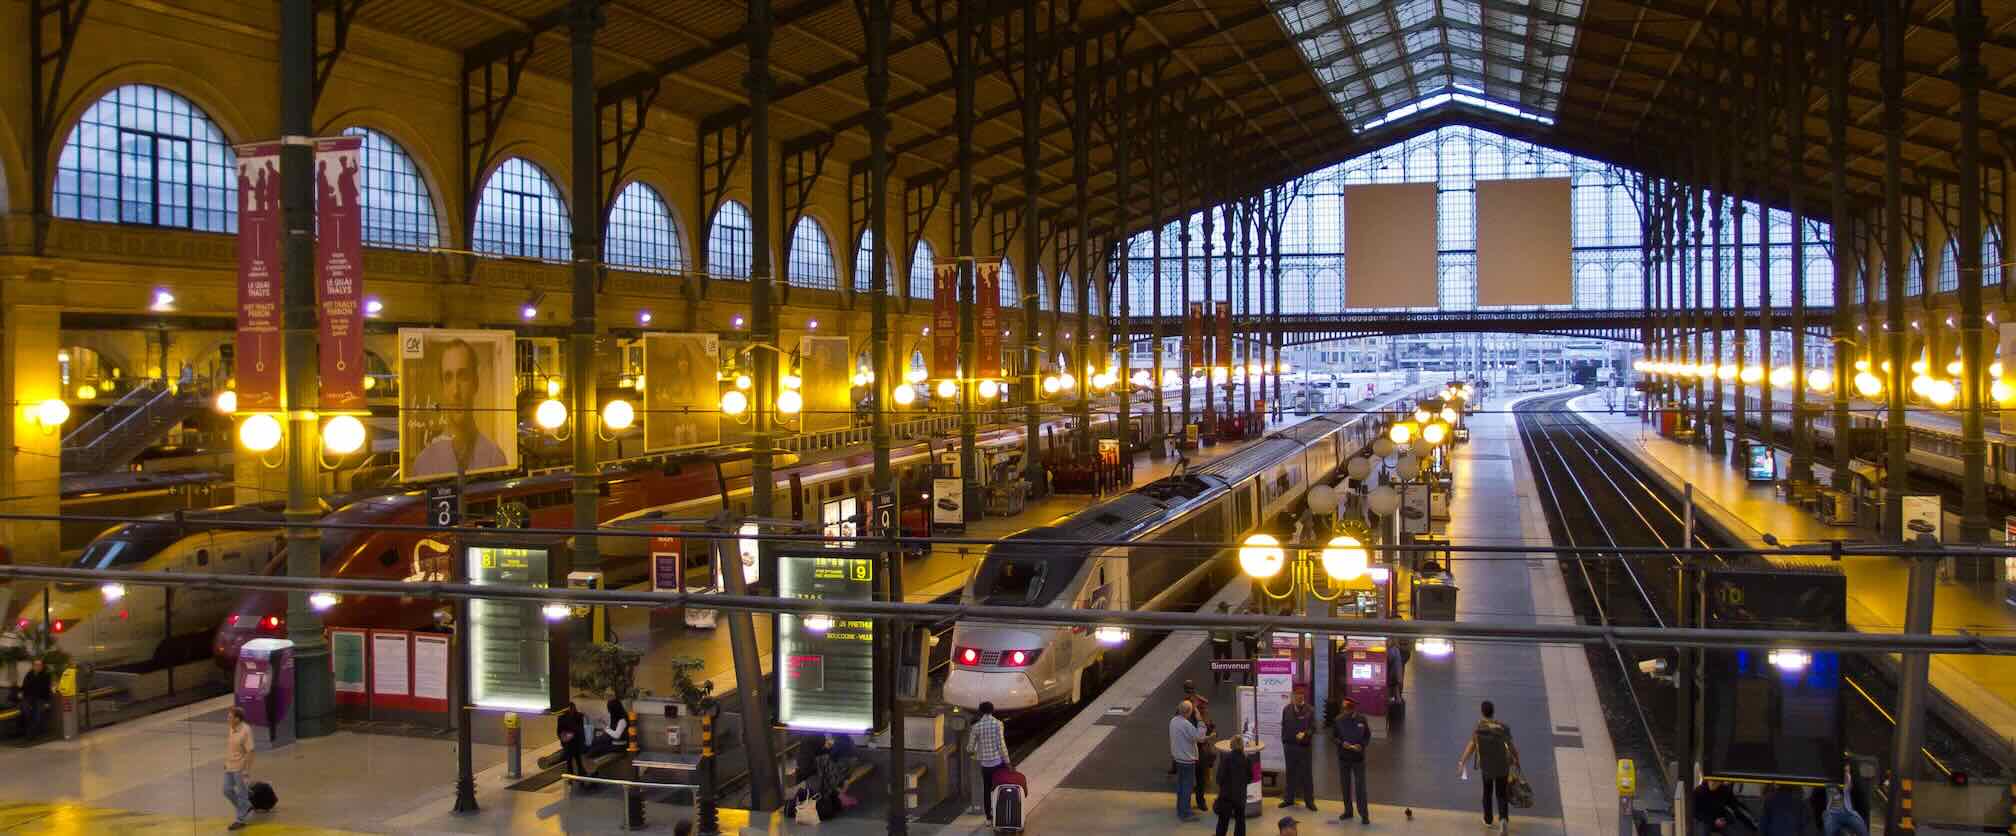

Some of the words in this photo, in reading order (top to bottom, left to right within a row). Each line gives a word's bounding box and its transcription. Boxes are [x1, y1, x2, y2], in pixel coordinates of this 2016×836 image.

[881, 510, 890, 537] 9
[856, 566, 866, 579] 9
[1211, 662, 1251, 670] Bienvenue
